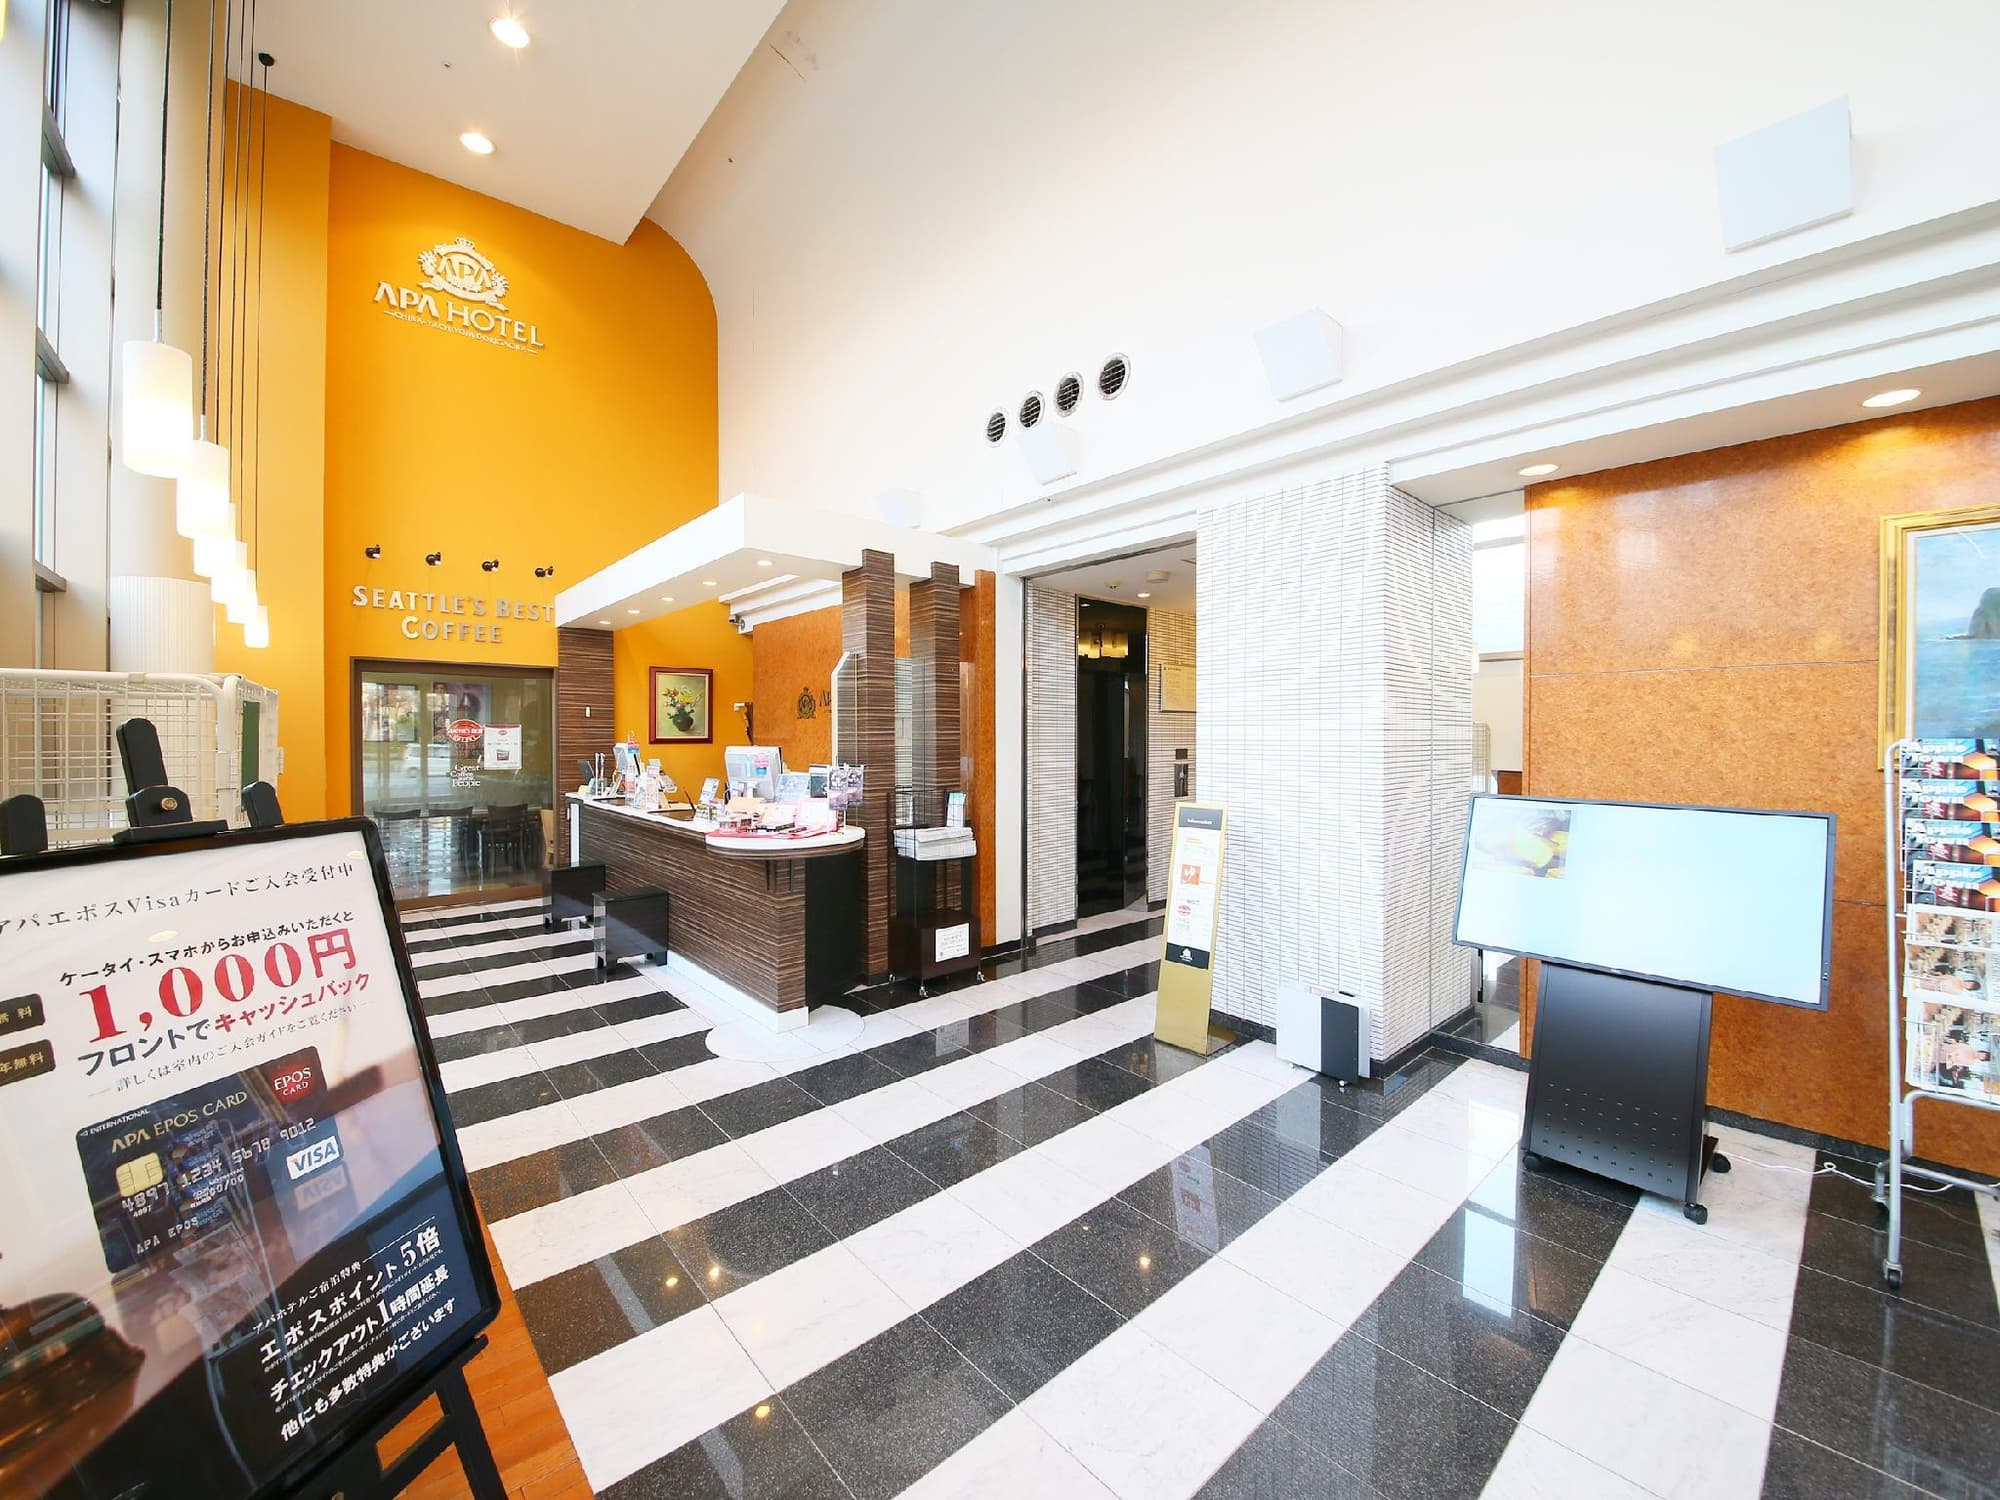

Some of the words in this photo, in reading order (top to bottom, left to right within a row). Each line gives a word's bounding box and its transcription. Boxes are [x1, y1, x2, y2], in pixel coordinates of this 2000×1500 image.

[374, 281, 440, 318] APA
[446, 301, 545, 347] HOTEL
[352, 585, 487, 616] SEATTLE'S
[496, 598, 554, 622] BEST
[401, 615, 503, 644] COFFEE
[79, 928, 357, 1043] 1,000円
[78, 973, 369, 1076] フロントでキャッシュバック
[274, 1067, 312, 1091] EPOS
[282, 1080, 309, 1097] CARD
[90, 1108, 150, 1135] INTERNATIONAL
[112, 1128, 151, 1154] APA
[153, 1109, 199, 1137] EPOS
[202, 1091, 248, 1116] CARD
[121, 1182, 170, 1212] 4897
[180, 1158, 223, 1188] 1234
[231, 1136, 271, 1166] 5678
[279, 1117, 316, 1141] 9012
[292, 1141, 338, 1173] VISA
[135, 1235, 161, 1255] APA
[167, 1216, 199, 1238] EPOS
[253, 1260, 361, 1335] アパホテルご宿泊特典
[270, 1264, 450, 1402] チェックアウト1時間延長
[280, 1297, 456, 1442] 他にも多数特典がございます
